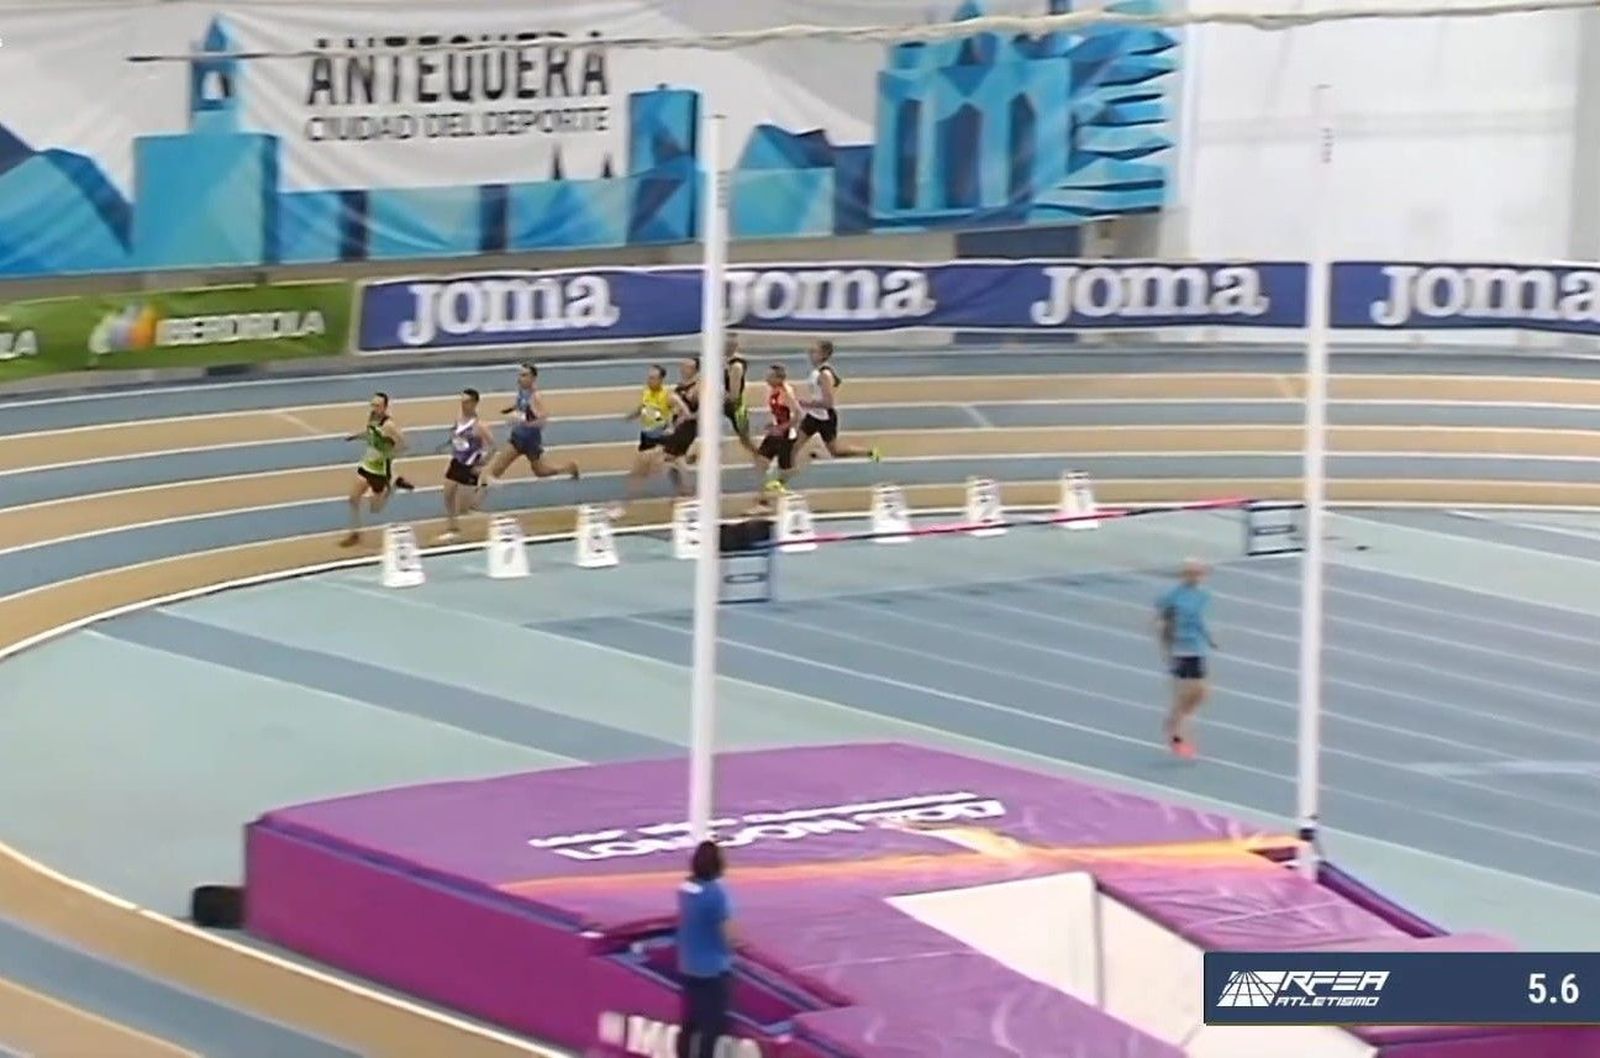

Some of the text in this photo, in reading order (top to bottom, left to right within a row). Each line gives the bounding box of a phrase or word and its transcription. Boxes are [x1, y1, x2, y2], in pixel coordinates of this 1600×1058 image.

[307, 31, 608, 105] ANTEQUERA
[305, 104, 609, 142] CIUDAD DEL DEPORTE
